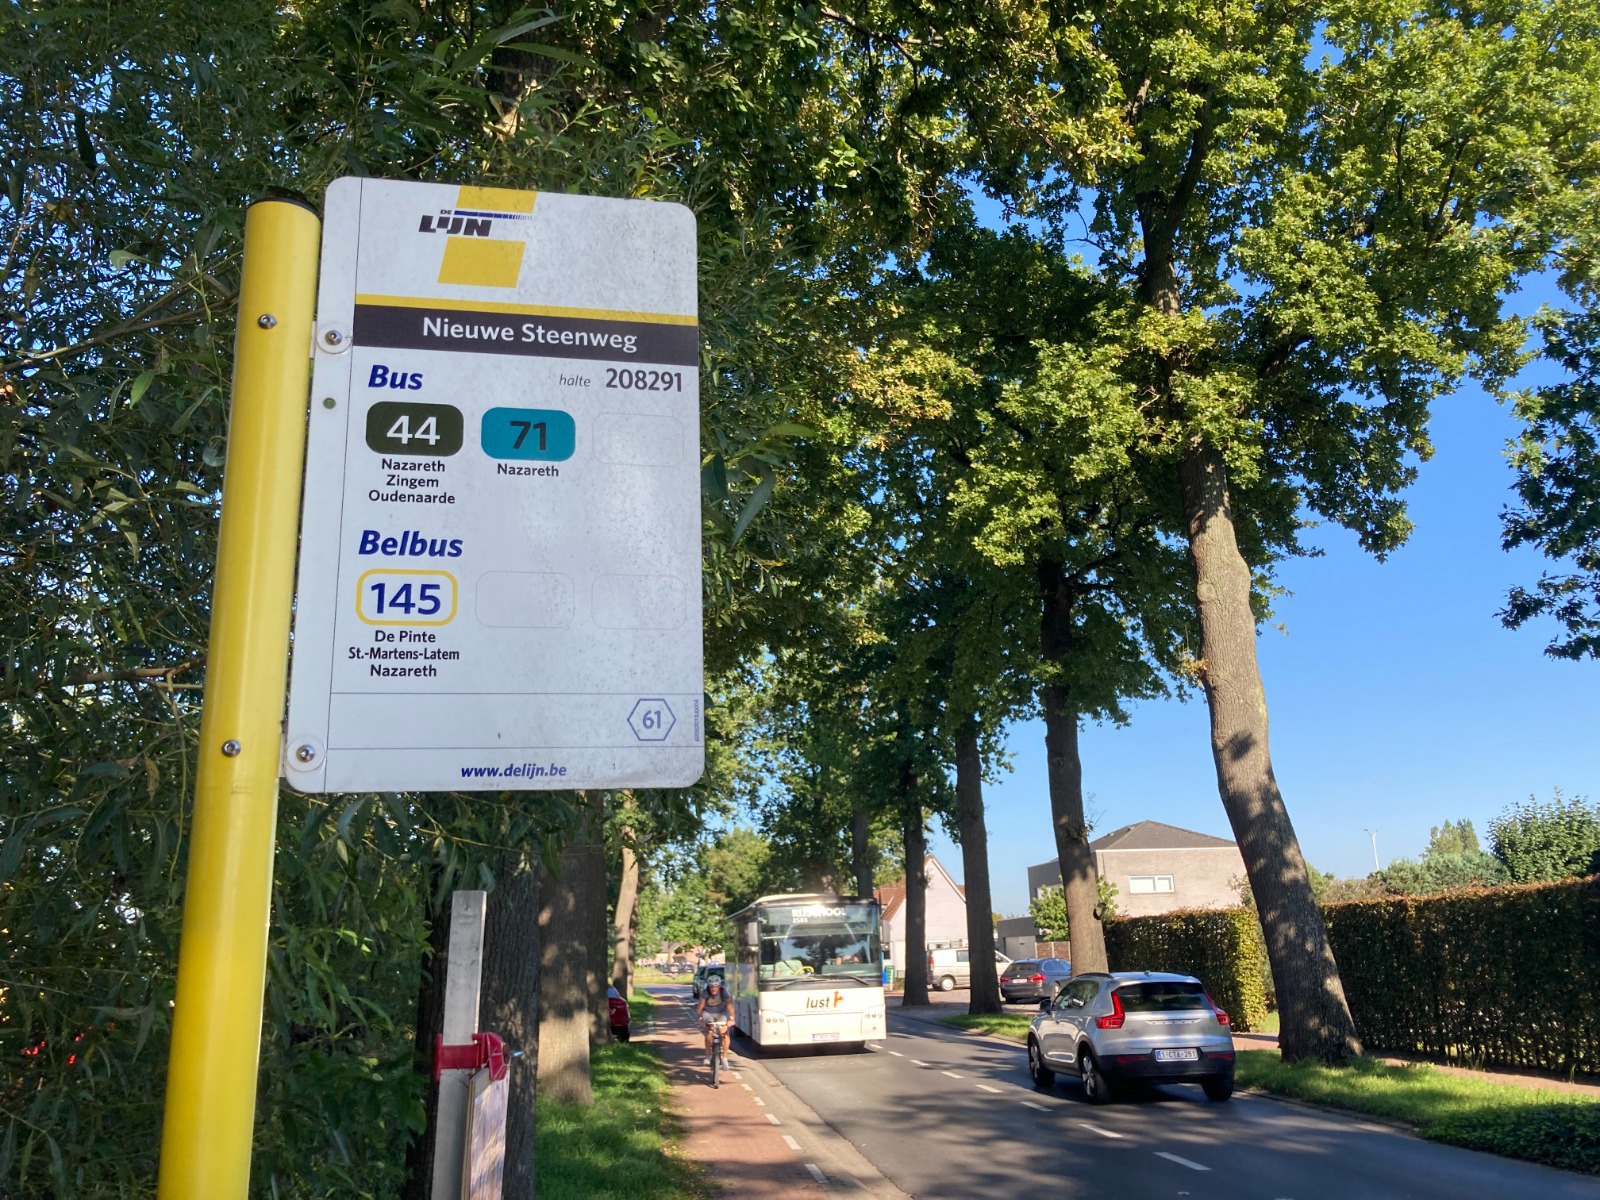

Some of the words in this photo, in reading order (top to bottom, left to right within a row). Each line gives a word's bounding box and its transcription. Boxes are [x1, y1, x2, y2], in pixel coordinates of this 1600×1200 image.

[418, 214, 493, 237] LIJN
[422, 316, 515, 342] Nieuwe
[521, 323, 638, 353] Steenweg
[367, 364, 424, 390] Bus
[558, 373, 591, 388] halte
[604, 367, 683, 392] 208291
[386, 415, 441, 446] 44
[509, 420, 547, 451] 71
[381, 458, 446, 472] Nazareth
[497, 463, 559, 477] Nazareth
[386, 474, 439, 489] Zingem
[368, 489, 456, 504] Oudenaarde
[358, 529, 464, 558] Belbus
[370, 582, 442, 616] 145
[374, 630, 396, 643] De
[399, 629, 437, 643] Pinte
[348, 646, 460, 661] St.-Martens-Latem
[369, 663, 437, 678] Nazareth
[642, 709, 662, 730] 61
[460, 763, 567, 779] www.delijn.be
[806, 996, 830, 1009] lust
